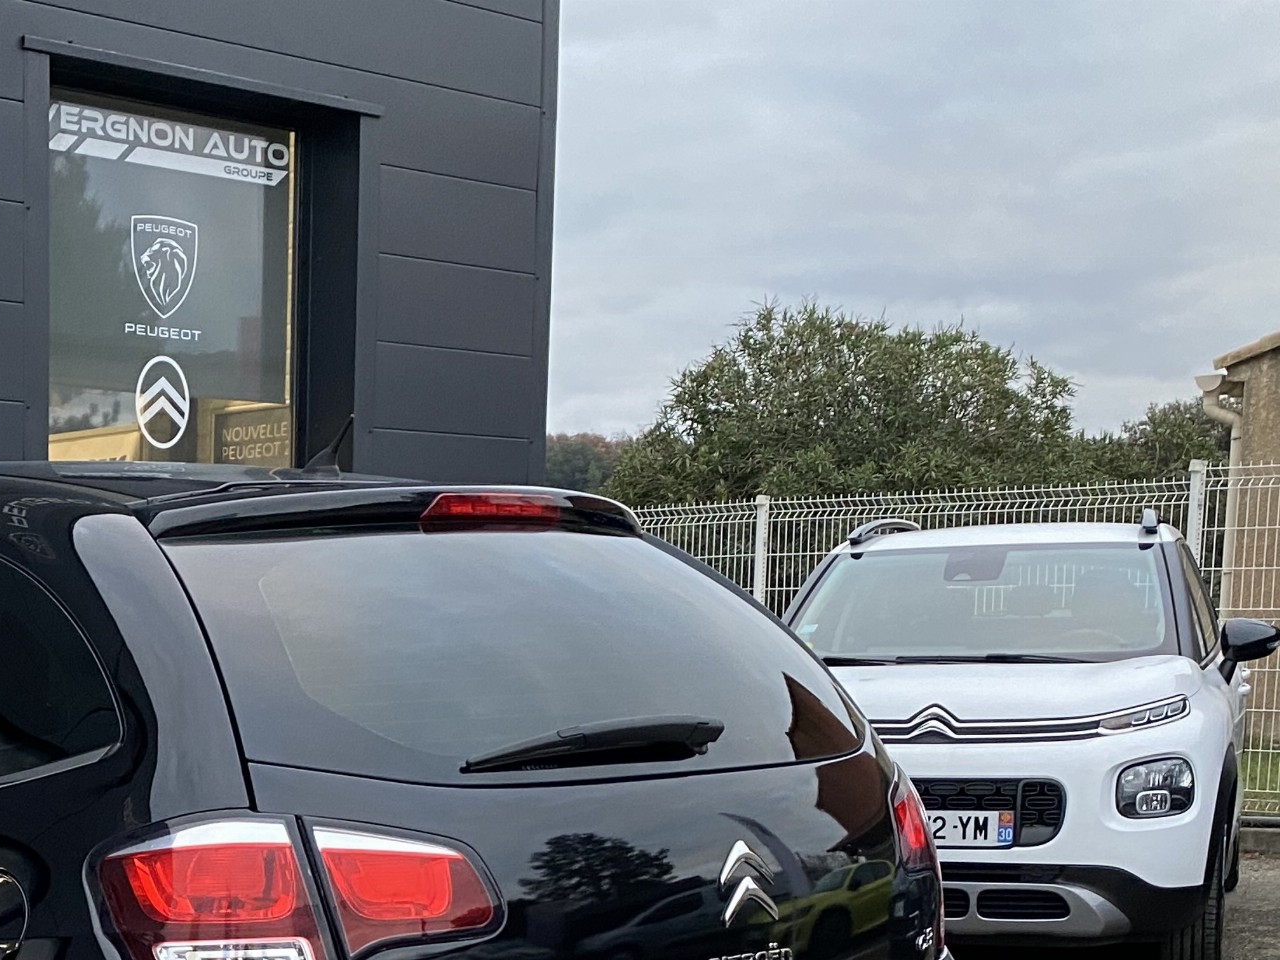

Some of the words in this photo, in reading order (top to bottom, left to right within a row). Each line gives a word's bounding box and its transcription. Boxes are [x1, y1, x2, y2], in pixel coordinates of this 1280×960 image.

[204, 132, 289, 167] AUTO
[223, 164, 274, 182] GROUPE
[137, 222, 192, 238] PEUGEOT
[124, 322, 202, 342] PEUGEOT
[222, 421, 288, 442] NOUVELLE
[222, 442, 281, 460] PEUGEOT
[928, 815, 989, 841] 2-YM
[999, 828, 1014, 841] 30
